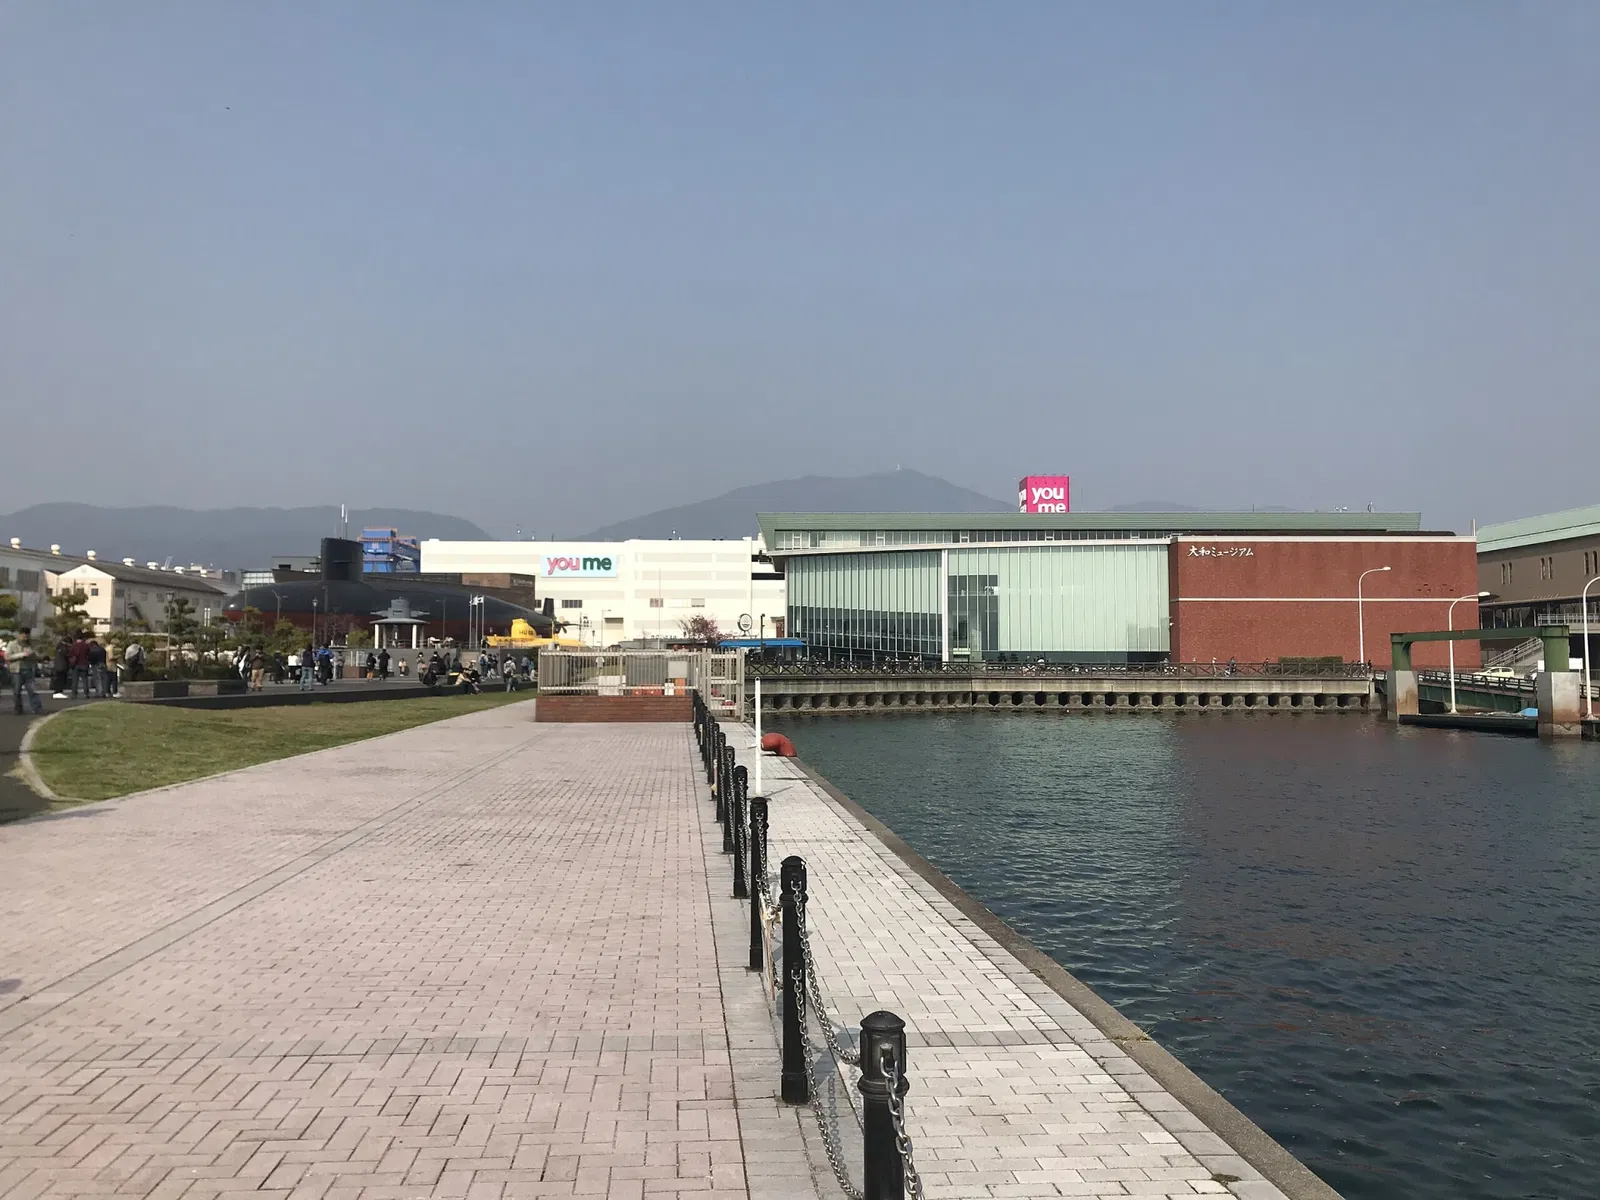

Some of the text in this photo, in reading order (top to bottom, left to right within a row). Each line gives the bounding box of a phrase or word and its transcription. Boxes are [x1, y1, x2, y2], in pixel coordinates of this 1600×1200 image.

[1031, 487, 1064, 504] you
[1037, 503, 1066, 513] me
[1187, 545, 1254, 557] 大和ミュージアム
